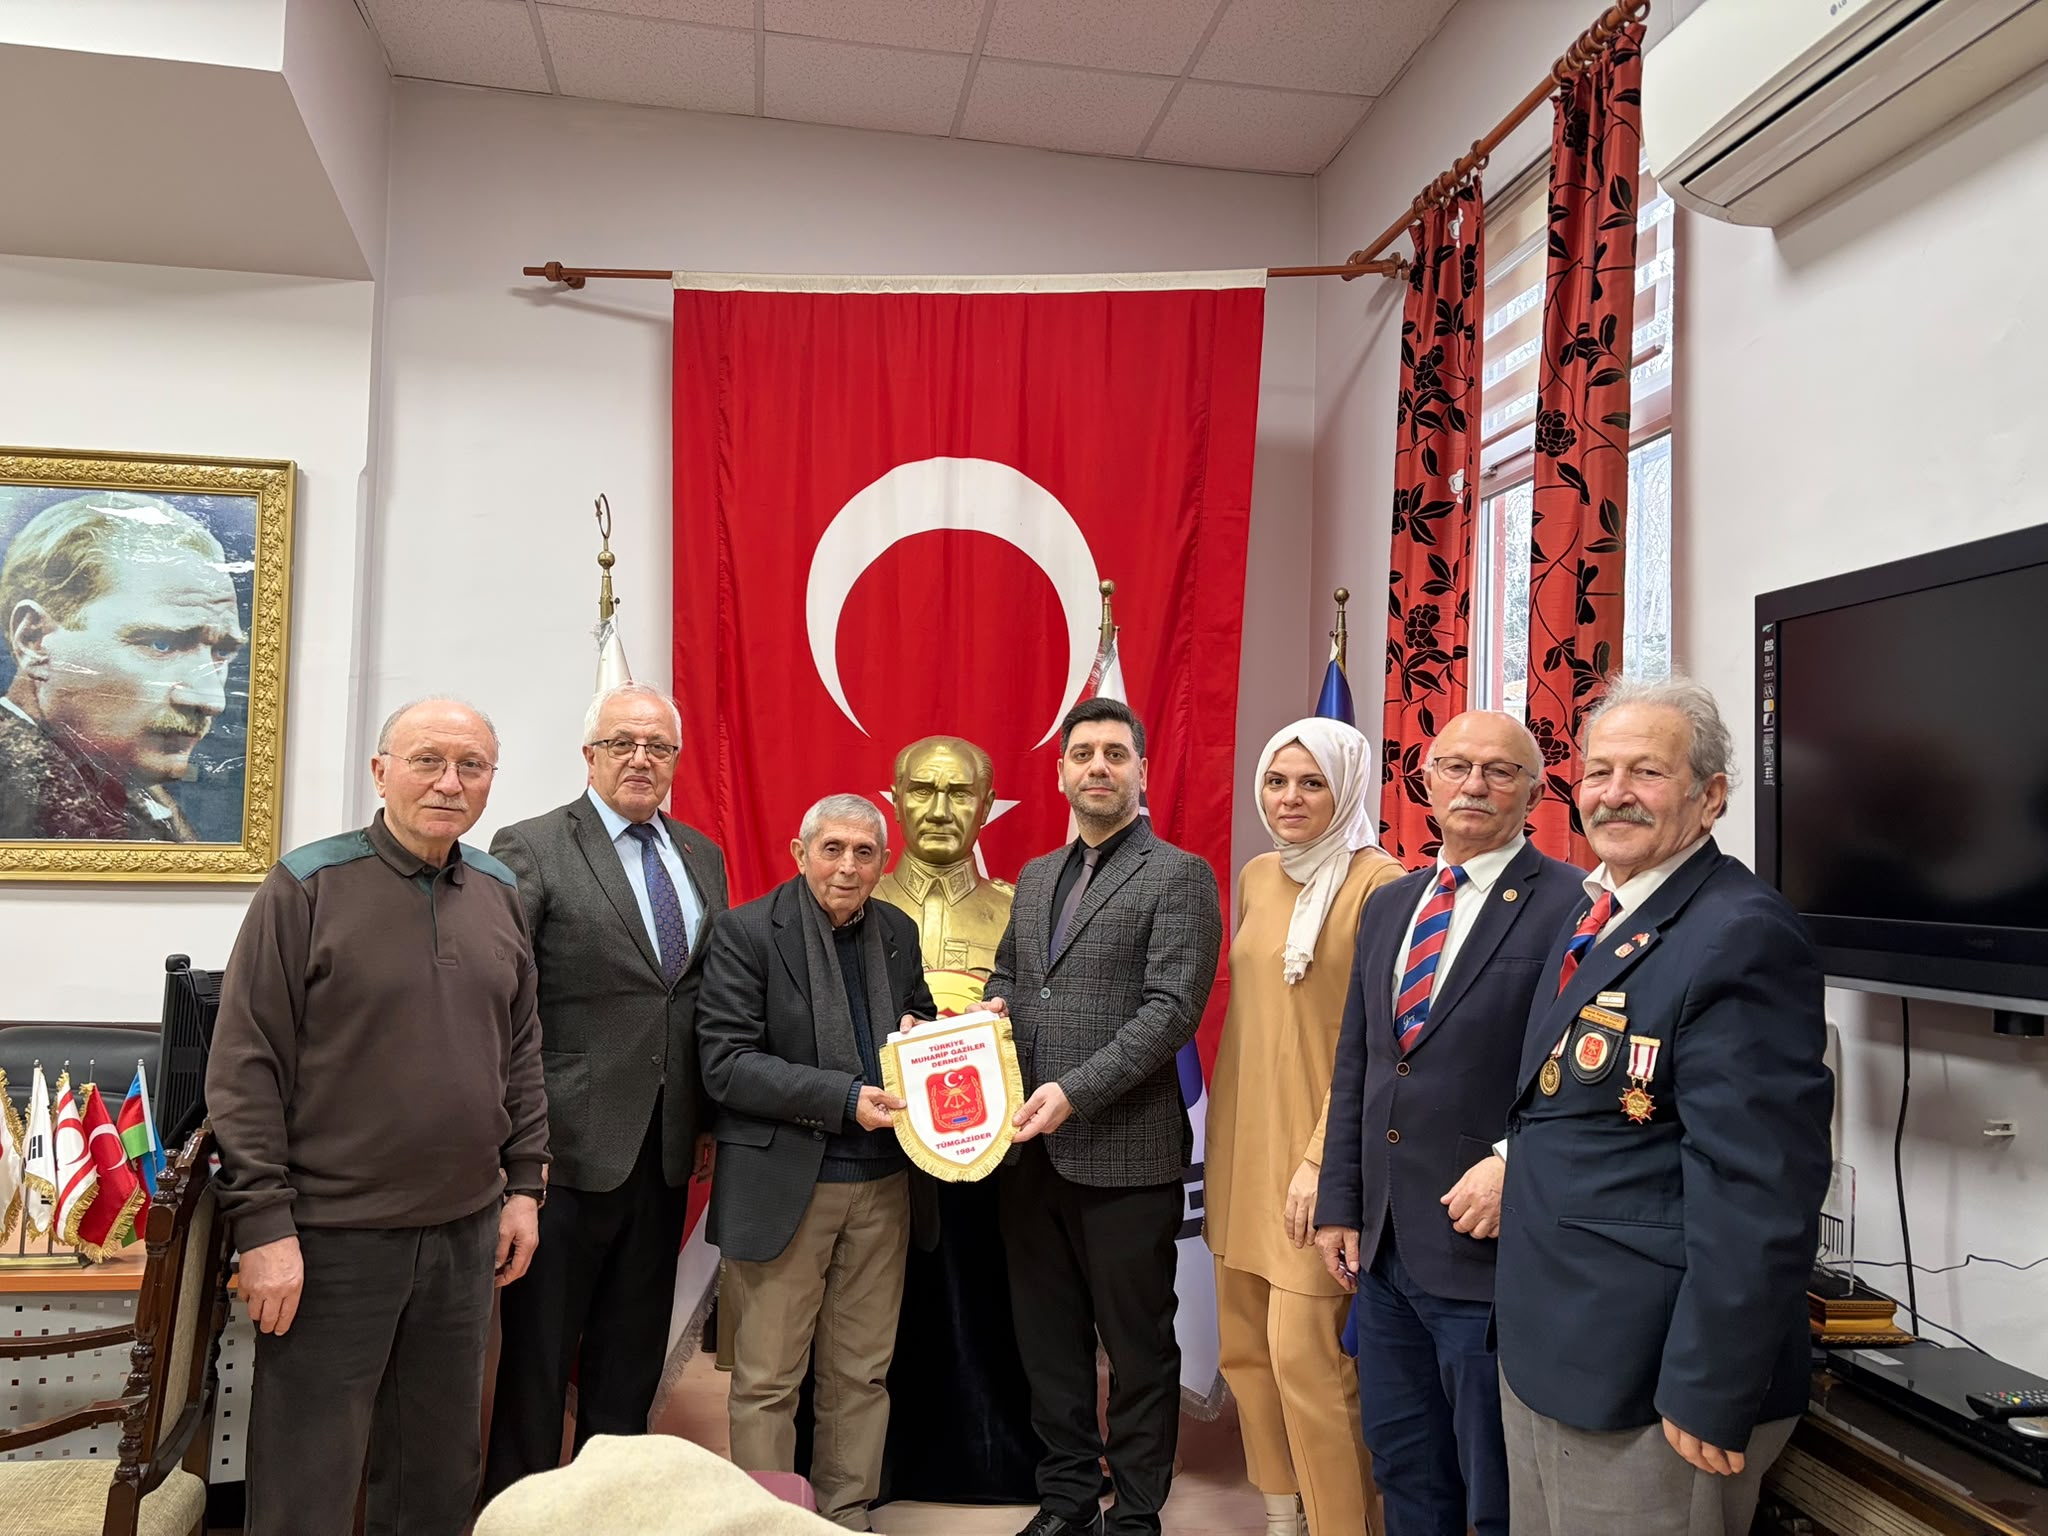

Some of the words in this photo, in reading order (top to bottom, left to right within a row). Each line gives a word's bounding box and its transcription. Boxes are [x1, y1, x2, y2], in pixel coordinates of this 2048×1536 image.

[929, 1039, 965, 1052] TÜRKİYE
[911, 1051, 949, 1065] MUHARİP
[951, 1042, 986, 1055] GAZİLER
[931, 1054, 968, 1068] DERNEĞİ
[936, 1132, 992, 1150] TÜMGAZİDER
[956, 1146, 976, 1156] 1984
